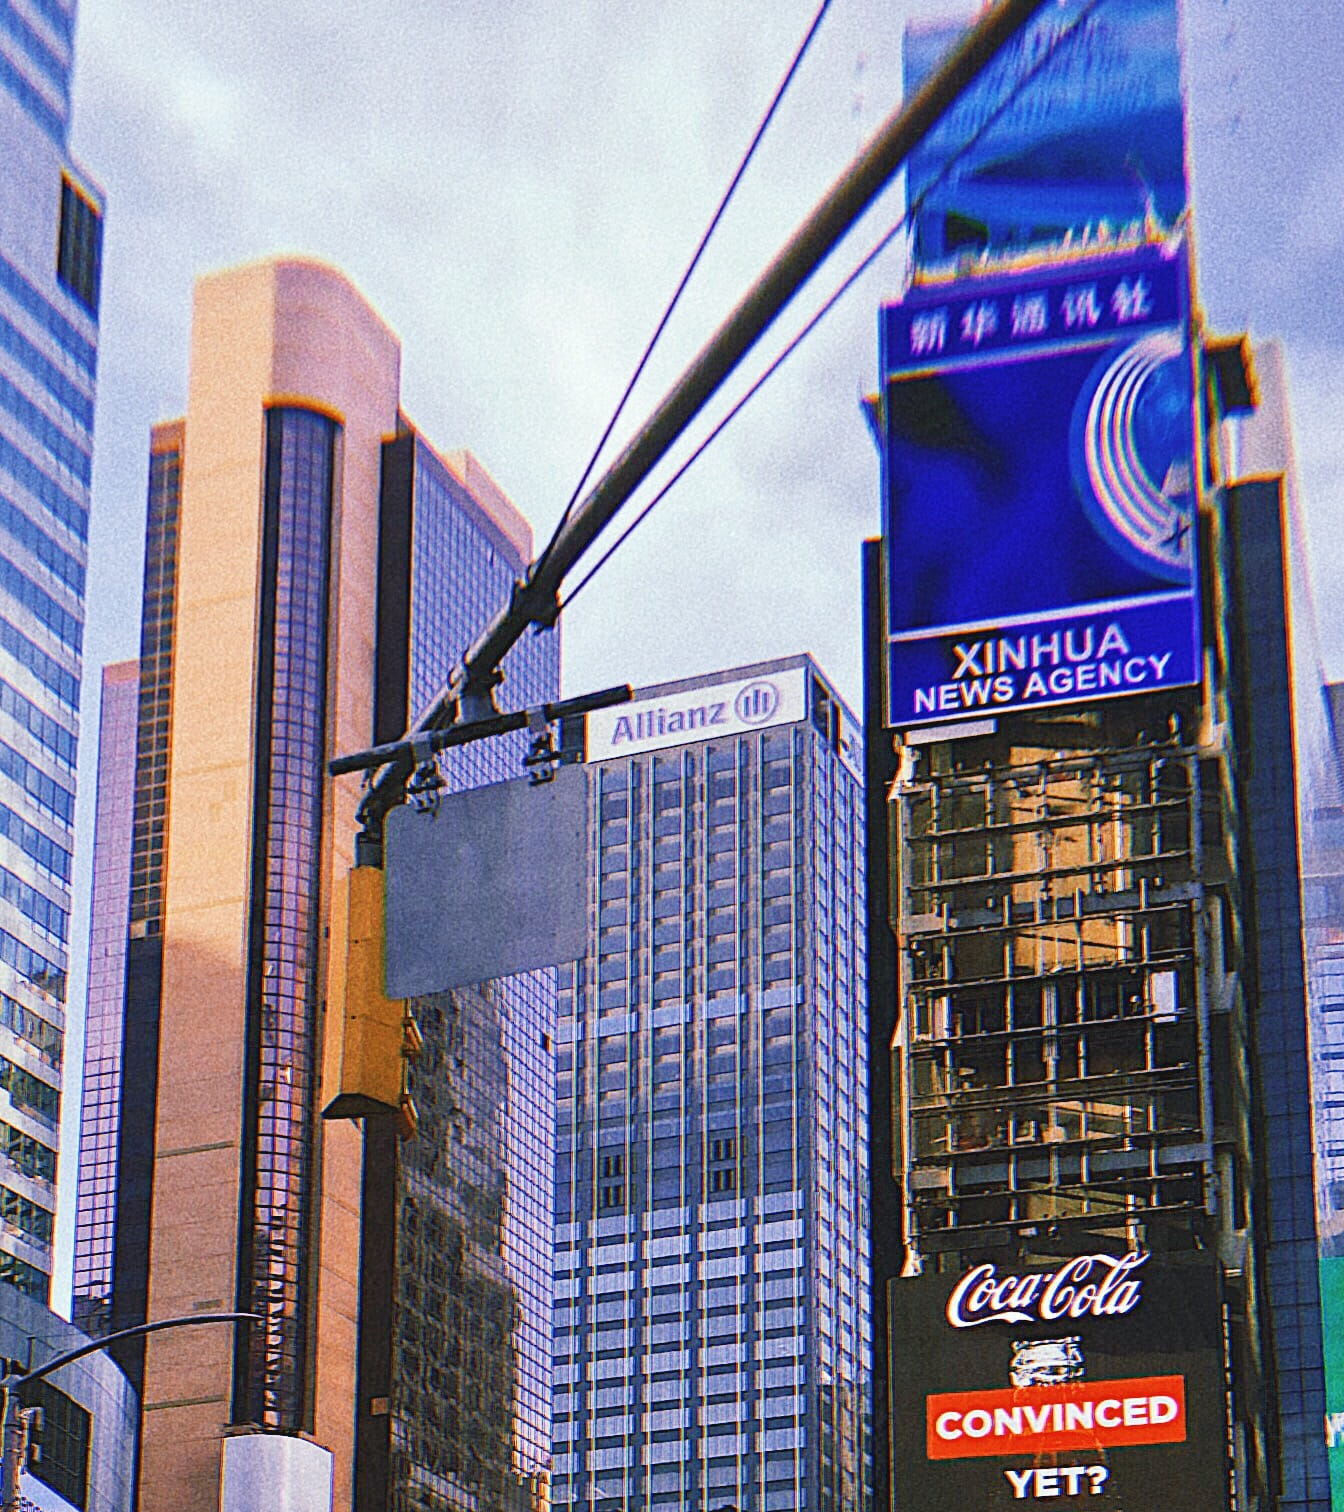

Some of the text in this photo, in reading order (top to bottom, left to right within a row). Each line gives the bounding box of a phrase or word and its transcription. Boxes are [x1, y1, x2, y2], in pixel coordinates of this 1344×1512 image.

[952, 622, 1131, 679] XINHUA
[913, 651, 1174, 714] NEWS AGENCY
[610, 702, 728, 747] Allianz
[946, 1250, 1152, 1328] Coca-Cola
[935, 1395, 1179, 1441] CONVINCED
[1005, 1465, 1110, 1499] YET?
